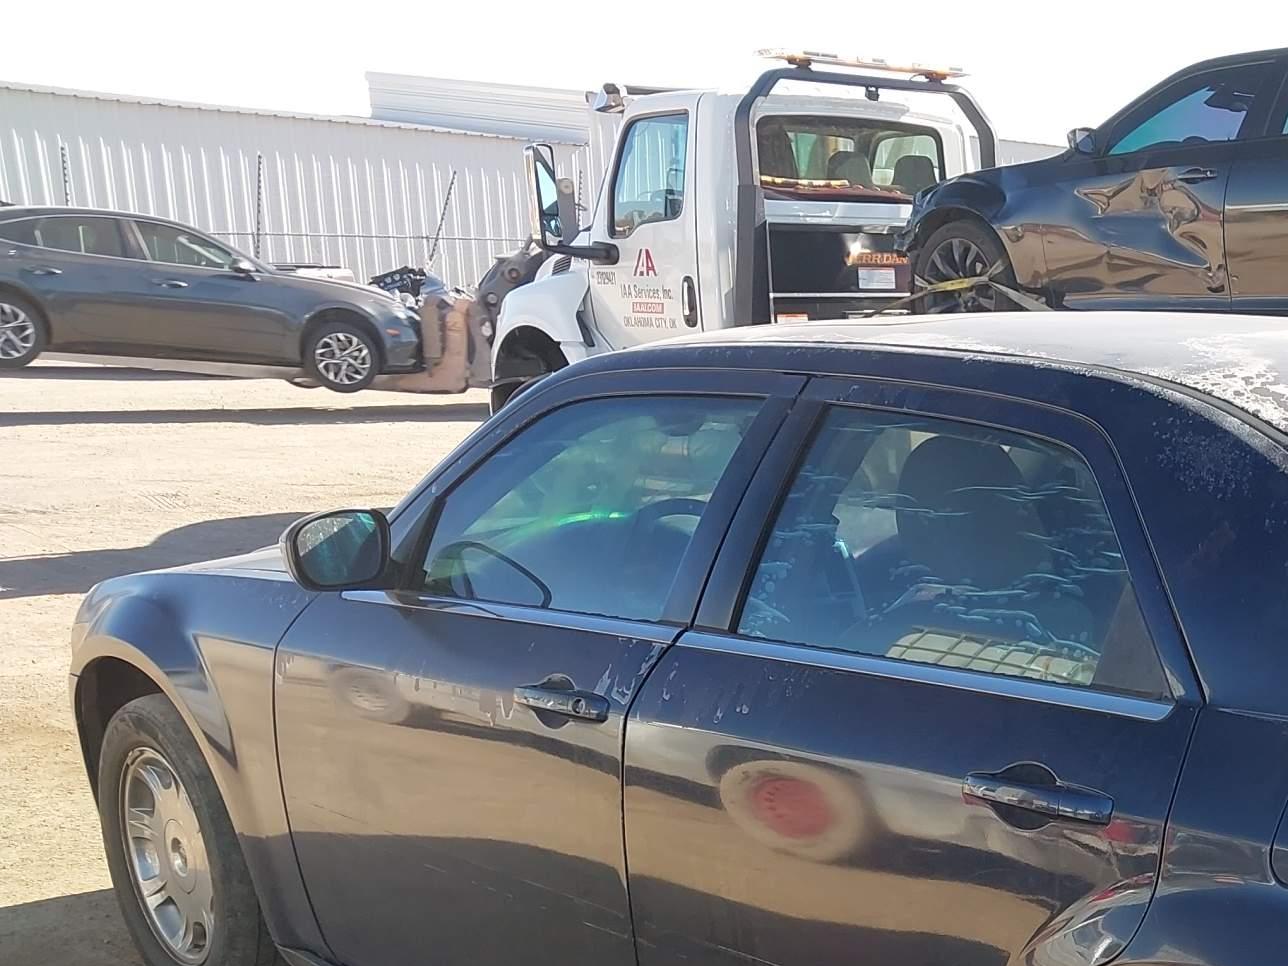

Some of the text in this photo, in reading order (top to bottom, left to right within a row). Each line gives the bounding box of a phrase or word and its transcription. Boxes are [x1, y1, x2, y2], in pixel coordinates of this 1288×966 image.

[620, 284, 674, 301] IAA Services, Inc.
[623, 315, 654, 328] OKLAHOMA
